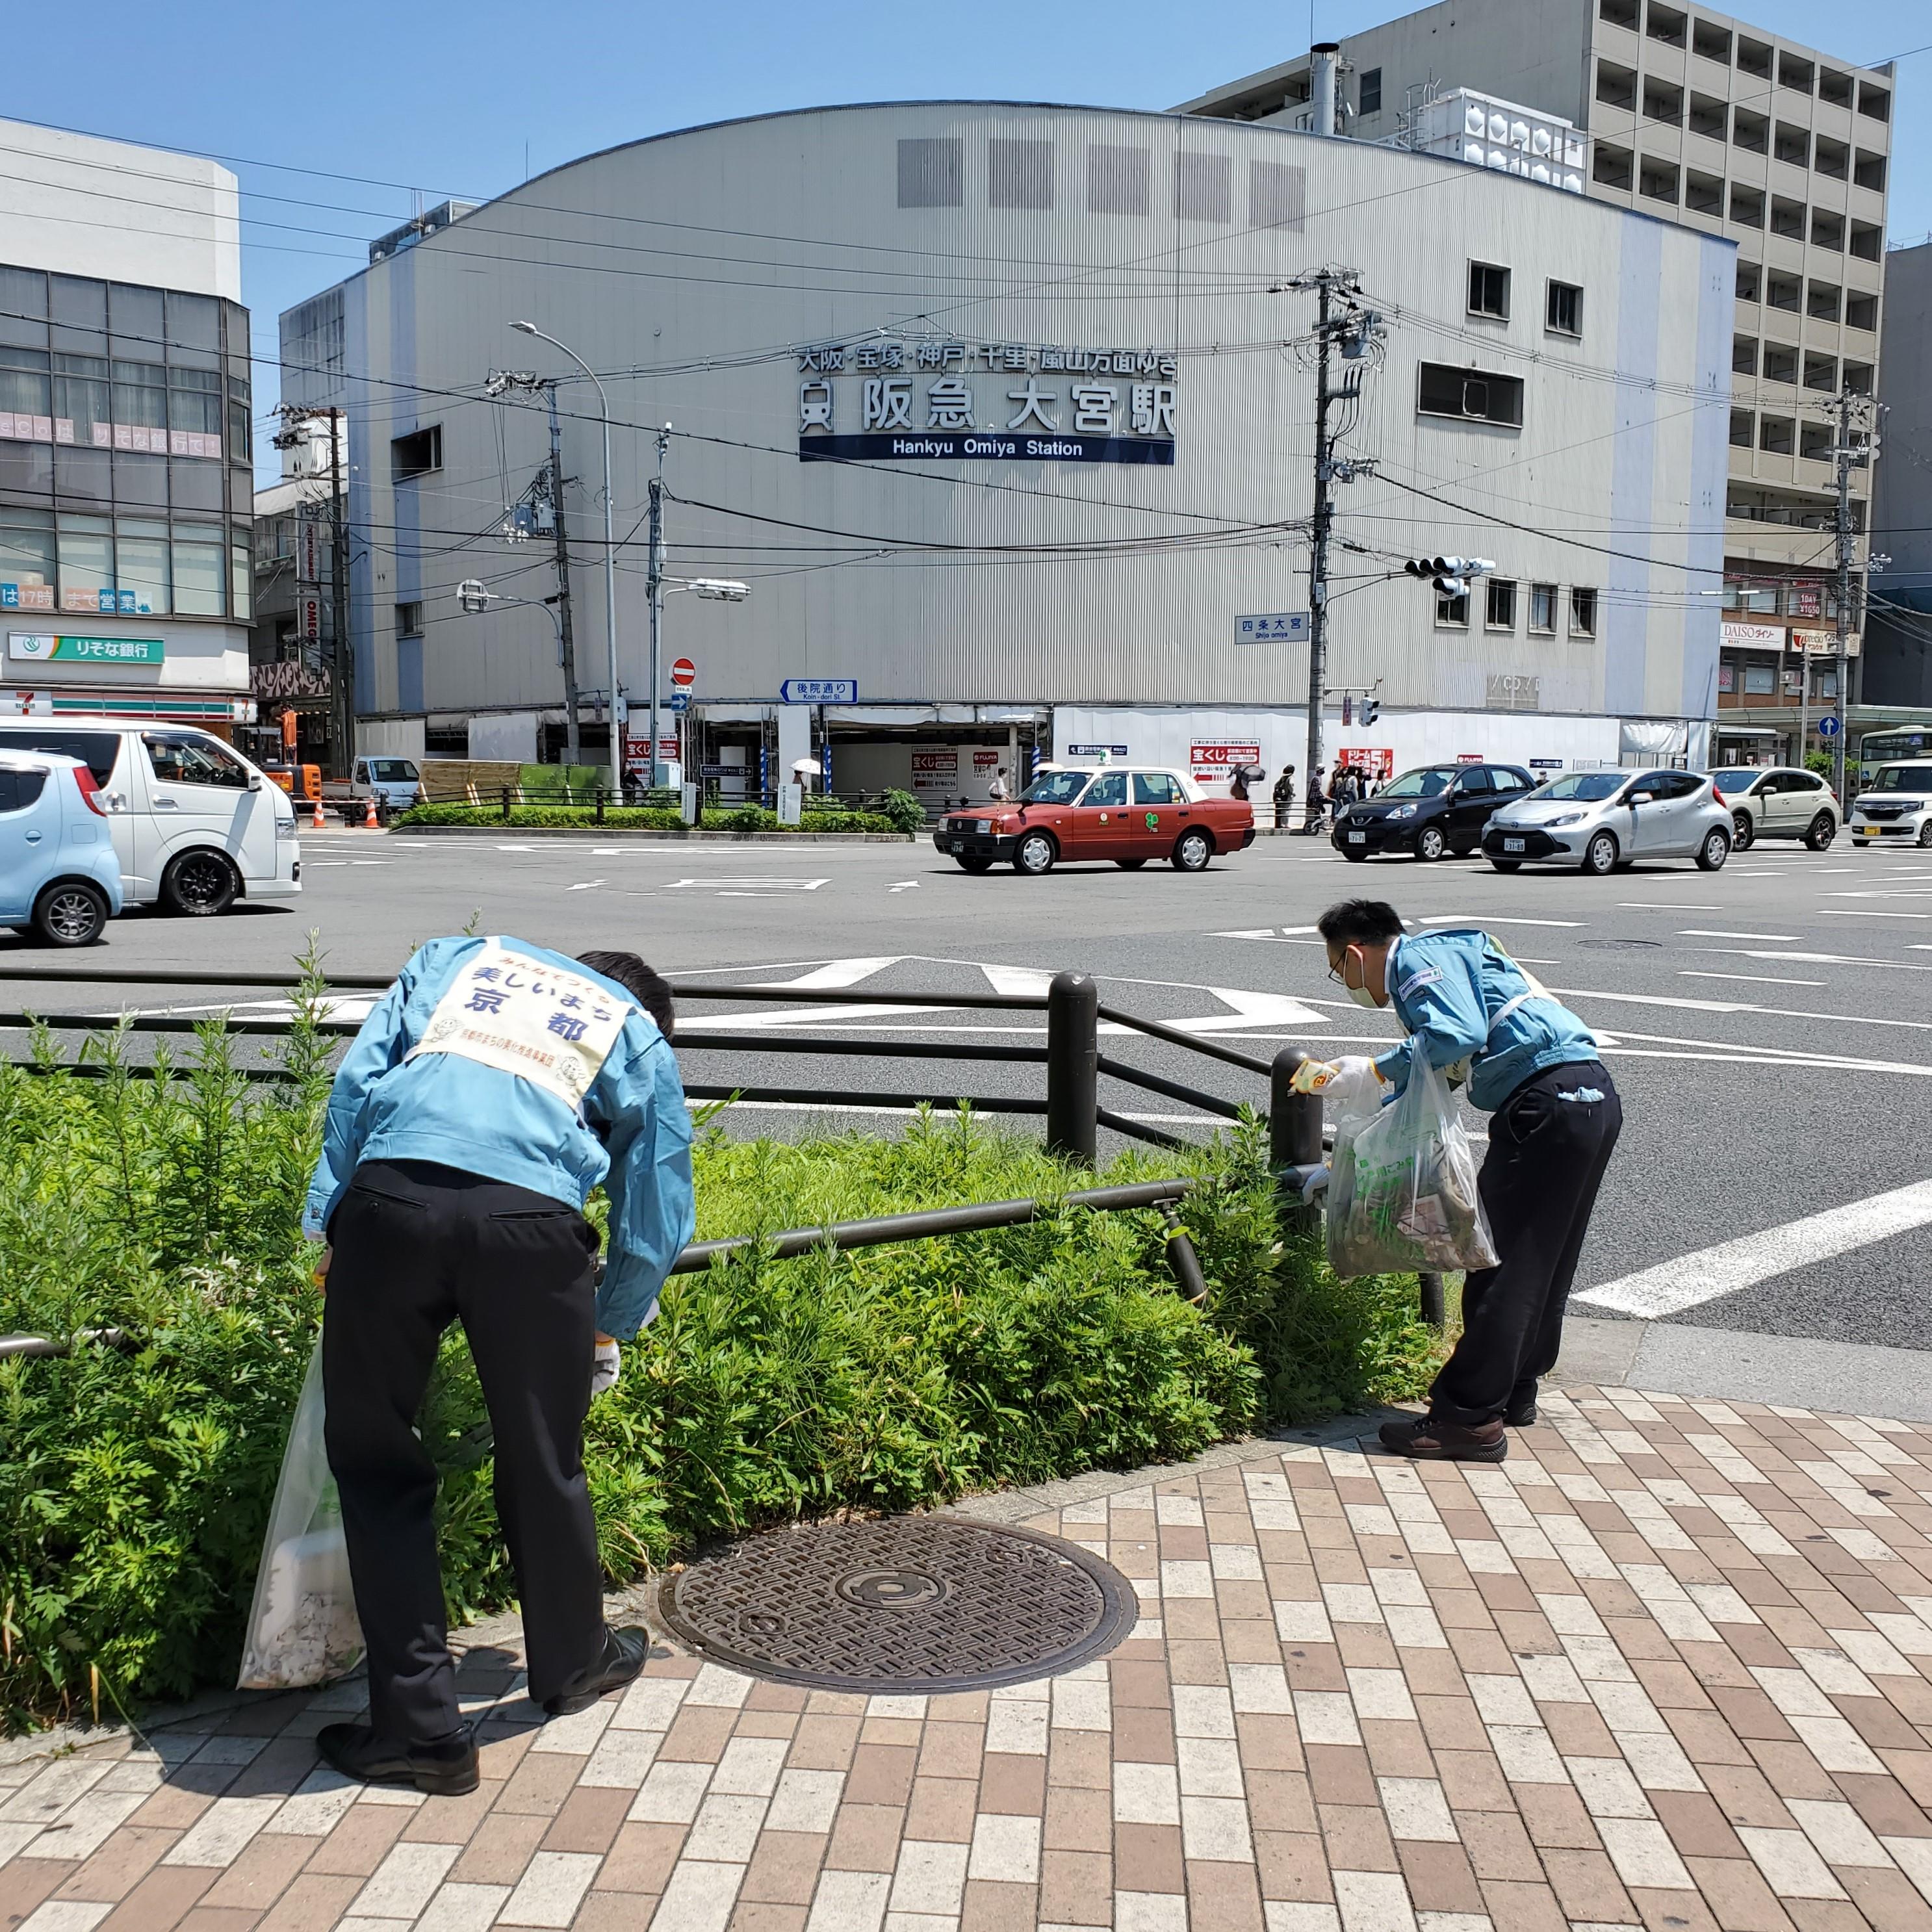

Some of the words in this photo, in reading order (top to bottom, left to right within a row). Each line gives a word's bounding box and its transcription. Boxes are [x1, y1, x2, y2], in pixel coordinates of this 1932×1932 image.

[863, 376, 976, 430] 阪急
[1007, 378, 1177, 435] 大宮駅
[893, 439, 953, 457] Hankyu
[964, 439, 1016, 457] Omiya
[1027, 440, 1083, 456] Station
[1243, 618, 1301, 632] 四条大宮
[1725, 625, 1755, 638] DAISO
[77, 641, 149, 658] りそな銀行
[797, 683, 845, 693] 後院通り
[913, 756, 934, 768] 宝くじ
[1192, 749, 1225, 761] 宝くじ
[498, 957, 610, 1003] みんなでつくる
[472, 966, 612, 1022] 美しいまち
[465, 986, 589, 1042] 京都
